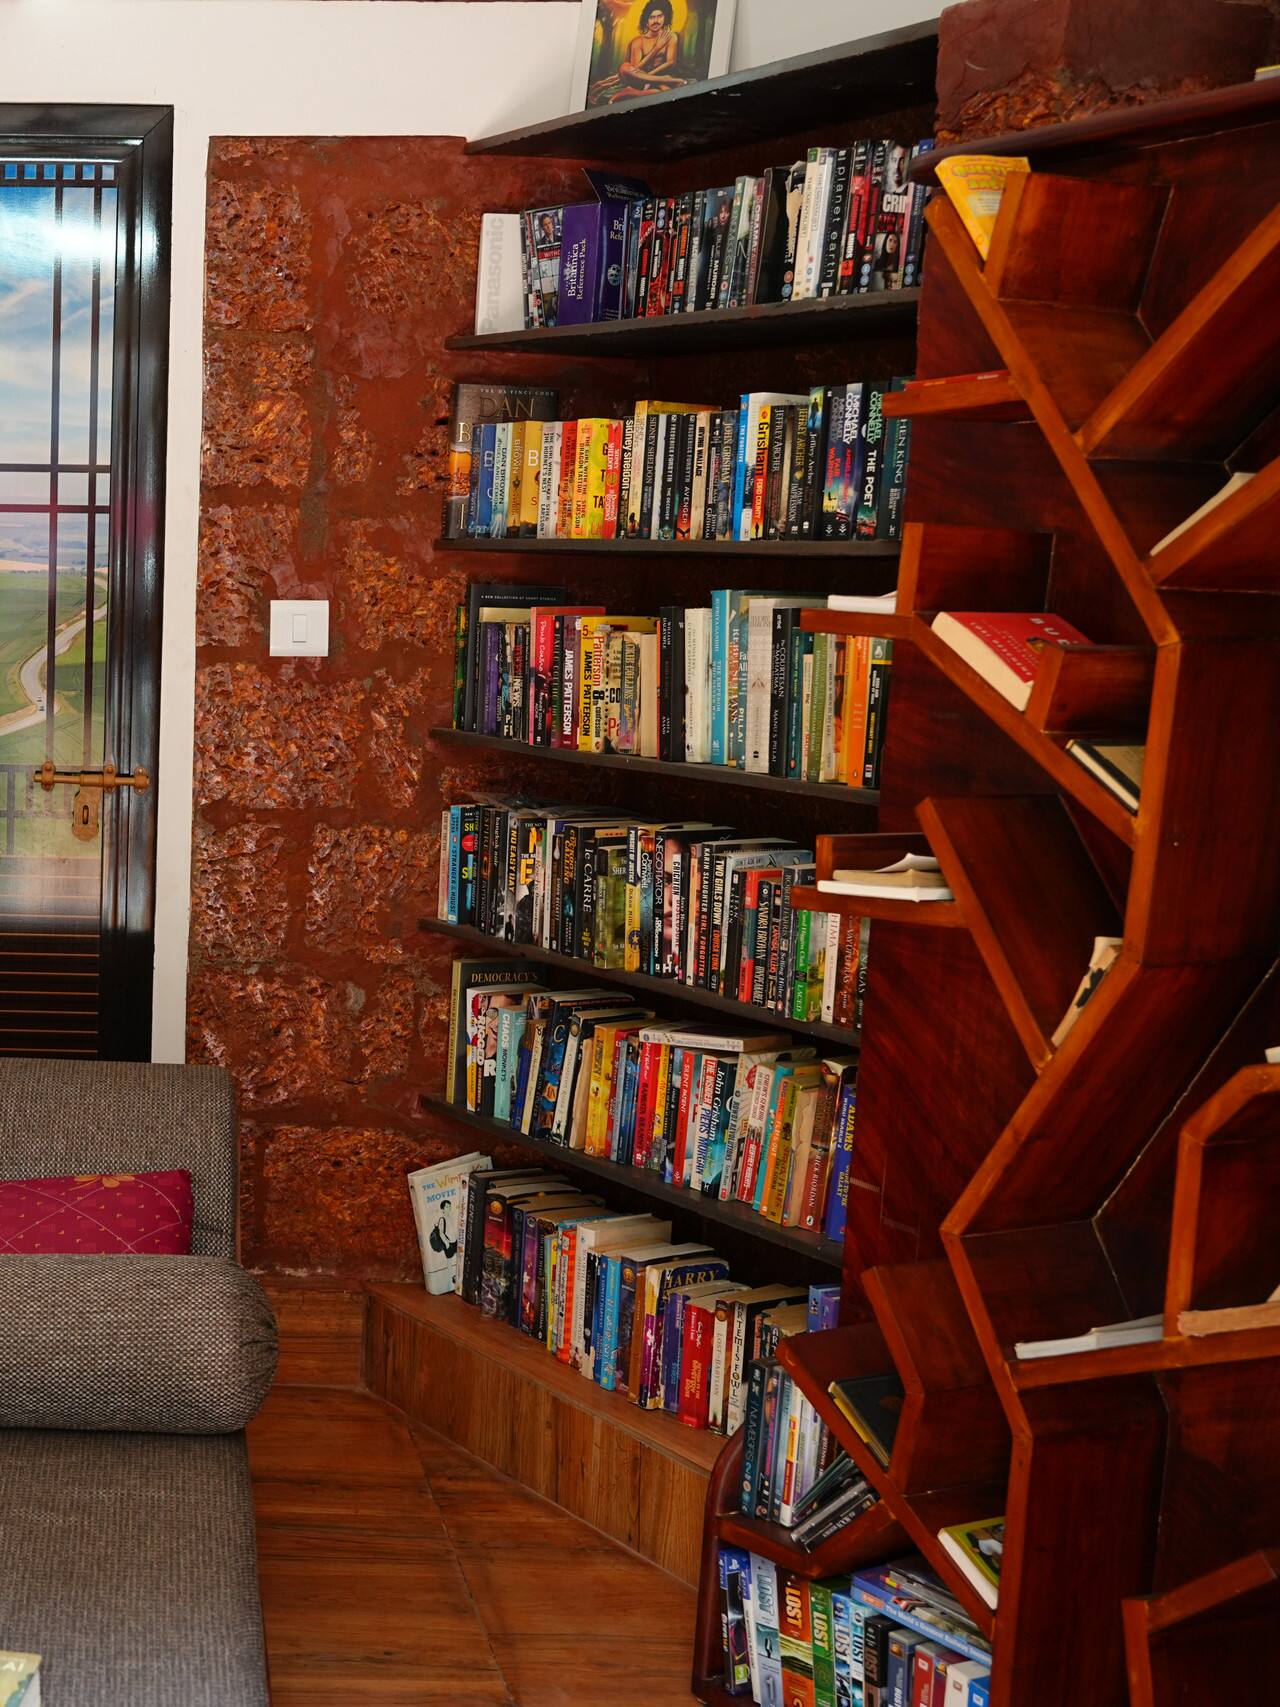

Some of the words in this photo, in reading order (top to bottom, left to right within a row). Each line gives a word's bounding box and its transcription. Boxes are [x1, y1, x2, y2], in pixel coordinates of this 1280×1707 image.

[832, 166, 846, 223] planet
[567, 243, 579, 297] Britannica
[823, 231, 838, 278] earth
[479, 216, 505, 332] Panasonic
[576, 259, 586, 300] Reference
[710, 260, 720, 300] MURDER
[478, 396, 535, 419] DAN
[796, 407, 808, 436] JEFFREY
[842, 392, 854, 445] CONNELLY
[850, 394, 861, 442] MICHAEL
[866, 391, 878, 444] CONNELLY
[648, 416, 657, 446] SIDNEY
[722, 422, 733, 445] JOHN
[774, 409, 784, 441] JEFFREY
[645, 446, 655, 484] SHELDON
[721, 446, 732, 483] GRISHAM
[755, 421, 769, 477] Grisham
[772, 440, 783, 472] ARCHER
[795, 437, 806, 467] ARCHER
[866, 449, 877, 472] THE
[894, 449, 905, 484] KING
[498, 469, 506, 505] BROWN
[755, 478, 763, 495] FORD
[788, 483, 799, 522] IMPRESSION
[863, 476, 875, 508] POET
[682, 486, 691, 524] AVENGER
[754, 495, 762, 519] COUNTY
[564, 648, 574, 680] JAMES
[584, 649, 592, 680] JAMES
[592, 636, 605, 687] Patterson
[512, 678, 523, 707] NEWS
[563, 682, 573, 735] PATTERSON
[582, 684, 592, 737] PATTERSON
[594, 706, 602, 738] confession
[511, 829, 518, 844] NO
[509, 845, 517, 867] EASY
[563, 839, 571, 885] CALLING
[654, 836, 663, 905] NEGOTIATOR
[702, 846, 710, 870] KARIN
[715, 860, 725, 877] TWO
[508, 869, 516, 894] DAY
[714, 878, 724, 901] GIRLS
[712, 901, 722, 926] DOWN
[756, 901, 768, 929] SANDRA
[698, 936, 706, 978] FORGOTTEN
[755, 931, 768, 960] BROWN
[470, 971, 538, 983] DEMOCRACY'S
[752, 965, 765, 1004] UNSPEAKABLE
[796, 984, 804, 1013] LACED
[501, 1013, 511, 1049] CHAOS
[500, 1048, 509, 1082] MONKEYS
[706, 1060, 716, 1075] THE
[714, 1067, 725, 1096] John
[703, 1075, 715, 1106] INSIDER
[699, 1107, 711, 1134] PIERS
[708, 1096, 721, 1141] Grisham
[843, 1103, 857, 1152] ADAMS
[695, 1135, 709, 1176] MORGAN
[812, 1154, 821, 1173] RICK
[422, 1182, 436, 1190] THE
[426, 1188, 457, 1204] MOVIE
[808, 1174, 818, 1208] RIORDAN
[734, 1302, 744, 1362] ARTEMIS
[730, 1363, 740, 1397] FOWL
[757, 1573, 775, 1616] LOST
[784, 1586, 803, 1631] LOST
[812, 1611, 828, 1651] LOST
[834, 1623, 851, 1666] LOST
[852, 1634, 864, 1667] LOST
